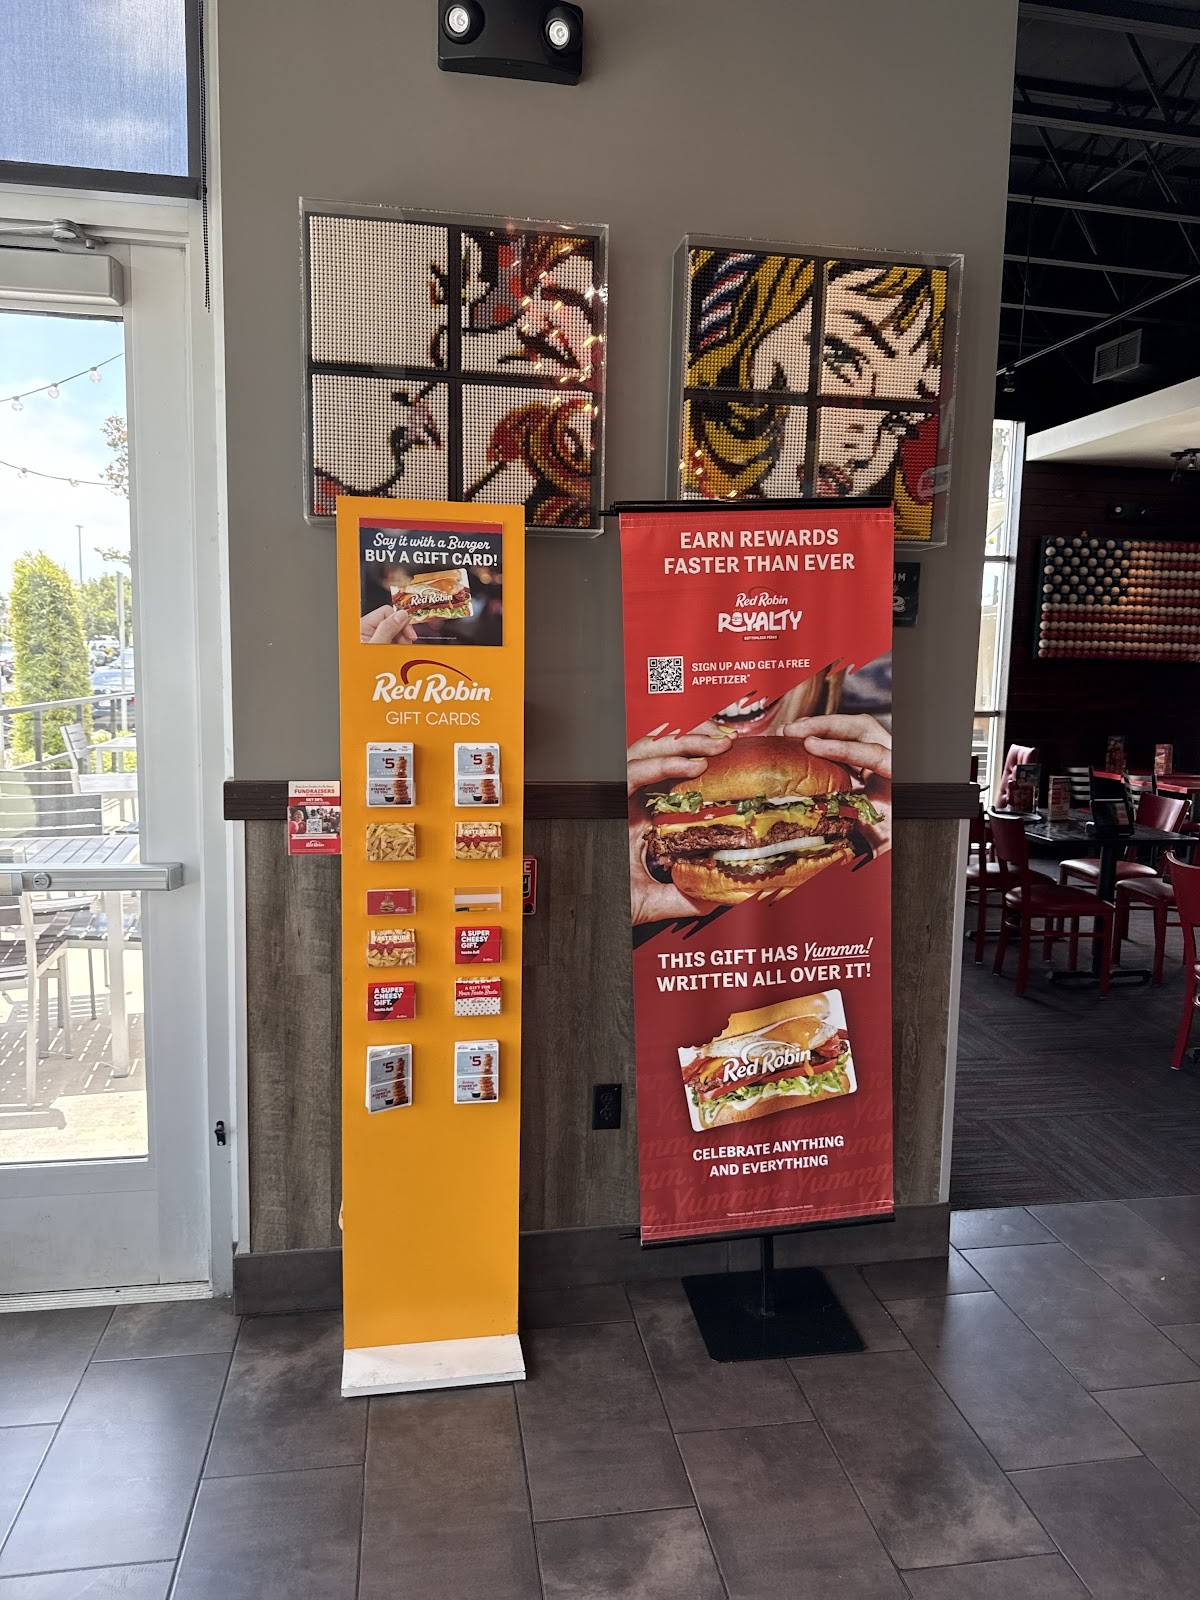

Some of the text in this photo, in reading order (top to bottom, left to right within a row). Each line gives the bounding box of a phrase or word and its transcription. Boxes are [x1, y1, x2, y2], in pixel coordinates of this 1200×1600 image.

[373, 532, 491, 553] Say it with a Burger
[680, 528, 839, 549] EARN REWARDS
[365, 549, 498, 567] BUY A GIFT CARD!
[664, 553, 855, 575] FASTER THAN EVER
[410, 591, 453, 606] Red Robin
[735, 591, 789, 608] Red Robin
[717, 608, 803, 633] ROYALTY
[691, 658, 811, 672] SIGN UP AND GET A FREE
[372, 671, 492, 704] Red Robin
[385, 711, 481, 726] GIFT CARDS
[657, 937, 874, 969] THIS GIFT HAS Yummm!
[656, 962, 872, 992] WRITTEN ALL OVER IT!
[722, 1047, 812, 1083] Red Robin
[692, 1135, 845, 1162] CELEBRATE ANYTHING
[709, 1162, 740, 1178] AND
[742, 1154, 829, 1175] EVERYTHING
